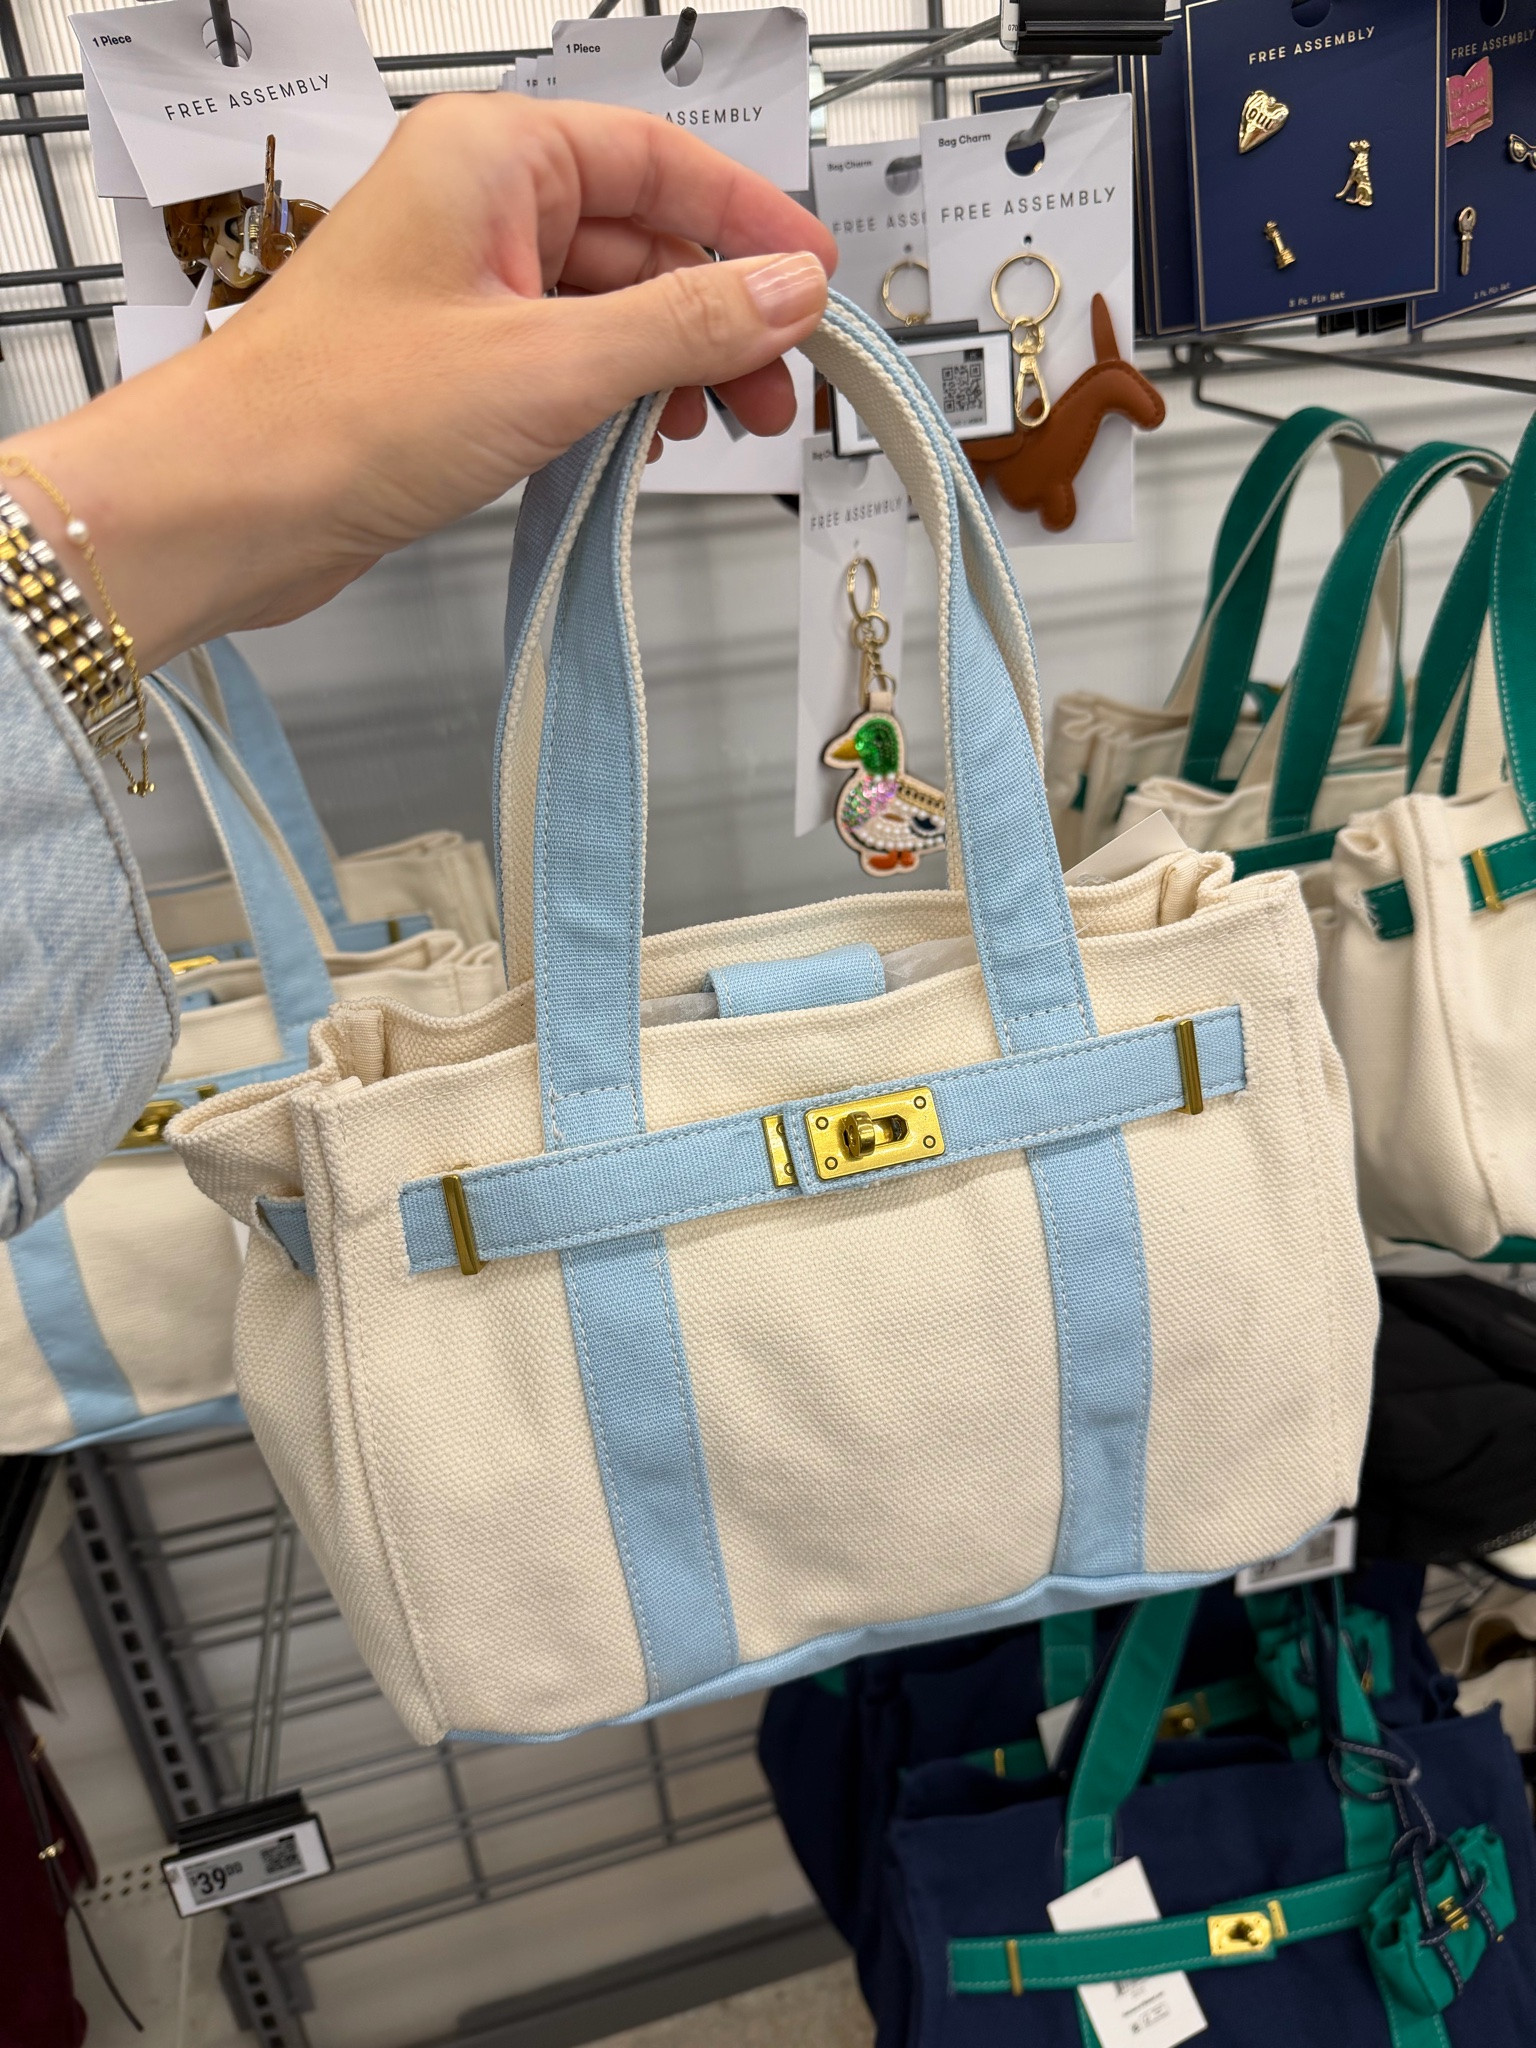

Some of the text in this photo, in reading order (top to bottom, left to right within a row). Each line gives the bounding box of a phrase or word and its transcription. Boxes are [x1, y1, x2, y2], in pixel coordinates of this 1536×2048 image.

[93, 34, 132, 48] 1 Piece
[566, 43, 601, 54] 1 Piece
[1249, 26, 1375, 65] FREE ASSEMBLY
[1451, 28, 1535, 60] FREE ASSEMBLY
[164, 74, 330, 121] FREE ASSEMBLY
[665, 106, 763, 125] ASSEMBLY
[938, 132, 991, 149] Bag Charm
[941, 187, 1116, 223] FREE ASSEMBLY
[832, 217, 877, 234] FREE
[811, 498, 902, 531] FREE ASSEMBLY
